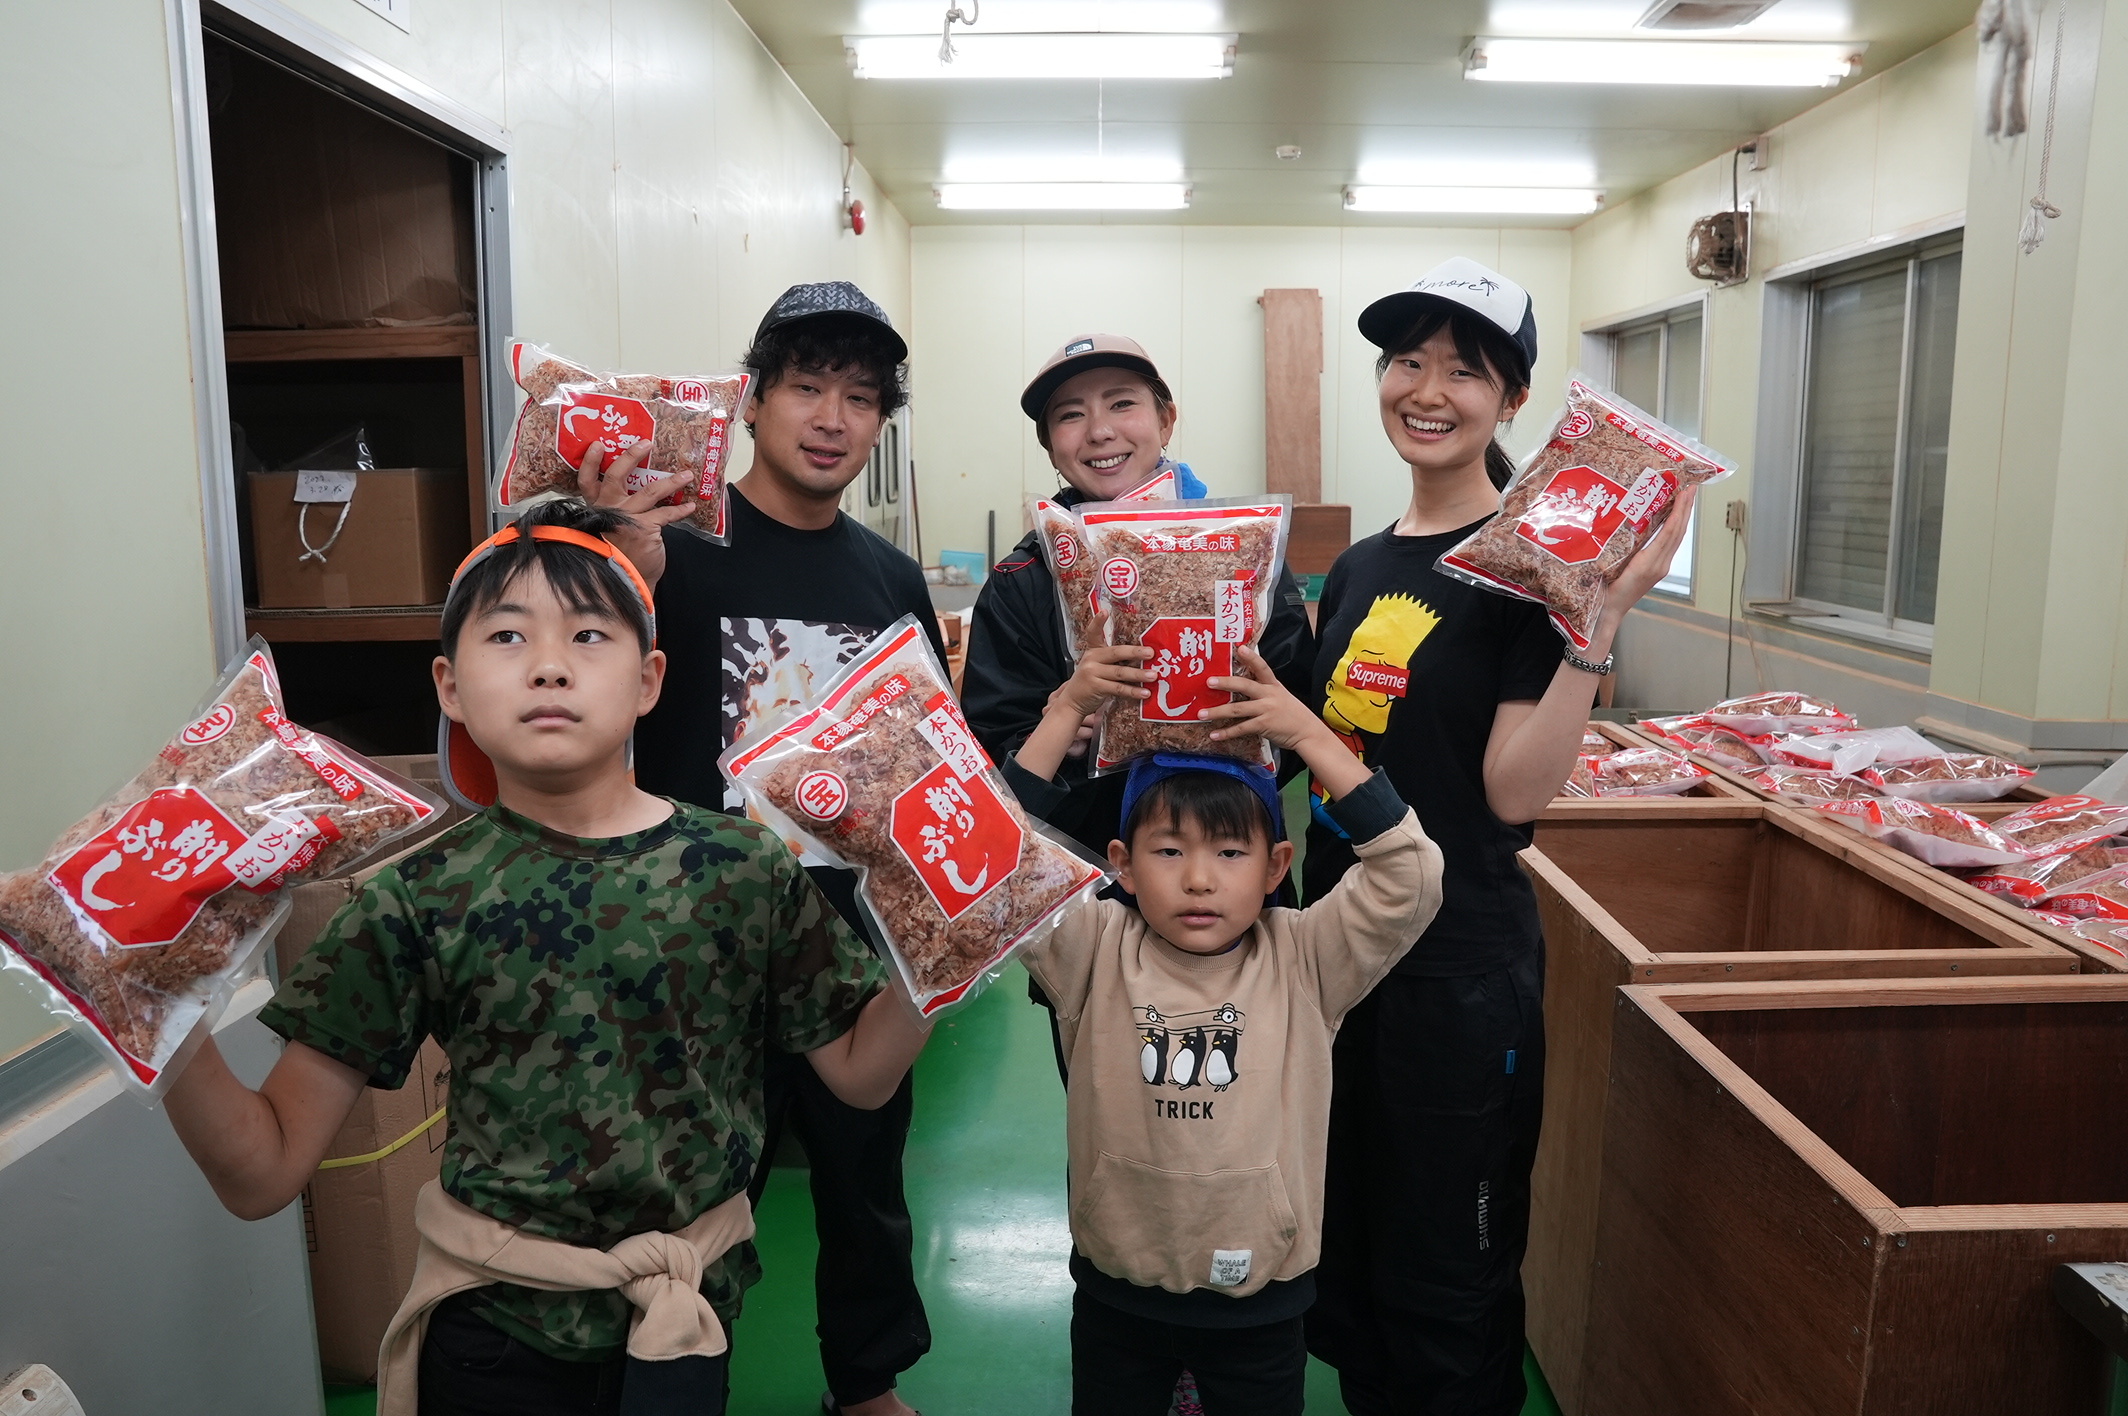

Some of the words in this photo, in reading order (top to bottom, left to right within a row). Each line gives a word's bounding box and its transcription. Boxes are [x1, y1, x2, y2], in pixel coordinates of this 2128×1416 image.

[700, 421, 723, 496] 本場奄美の味
[1624, 474, 1659, 516] 本かつお
[1146, 535, 1235, 551] 本場奄美の味
[1220, 582, 1239, 640] 本かつお
[1349, 664, 1406, 689] Supreme
[817, 678, 908, 749] 本場奄美の味
[928, 715, 978, 774] 本かつお
[1155, 1099, 1214, 1119] TRICK
[1478, 1180, 1489, 1250] SHIMANO
[1217, 1258, 1247, 1267] WHALE
[1220, 1267, 1233, 1275] OF
[1234, 1267, 1241, 1275] A
[1220, 1274, 1241, 1282] TIME
